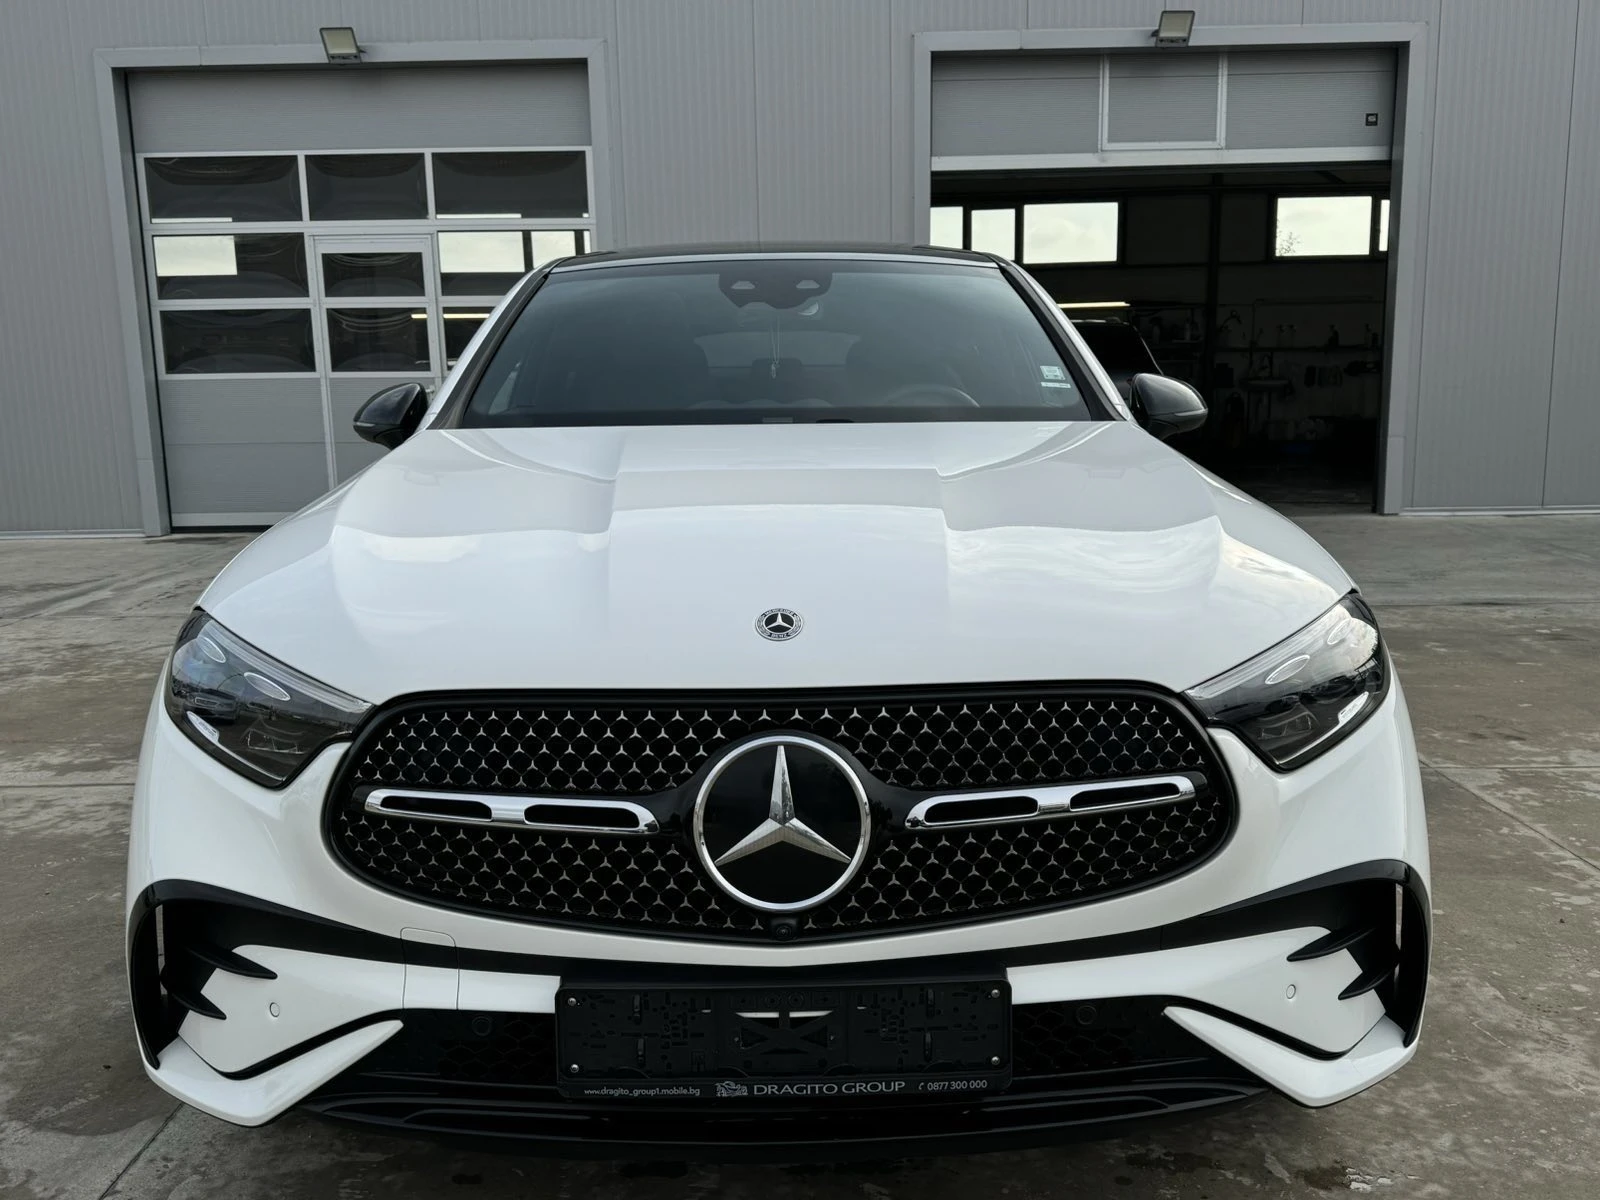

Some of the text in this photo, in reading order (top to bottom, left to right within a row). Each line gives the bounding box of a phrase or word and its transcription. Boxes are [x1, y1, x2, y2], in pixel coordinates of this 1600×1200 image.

[753, 1081, 906, 1096] DRAGITO GROUP
[927, 1080, 988, 1091] 0877 300 000
[584, 1086, 700, 1097] www.dragito_group1.mobile.bg
